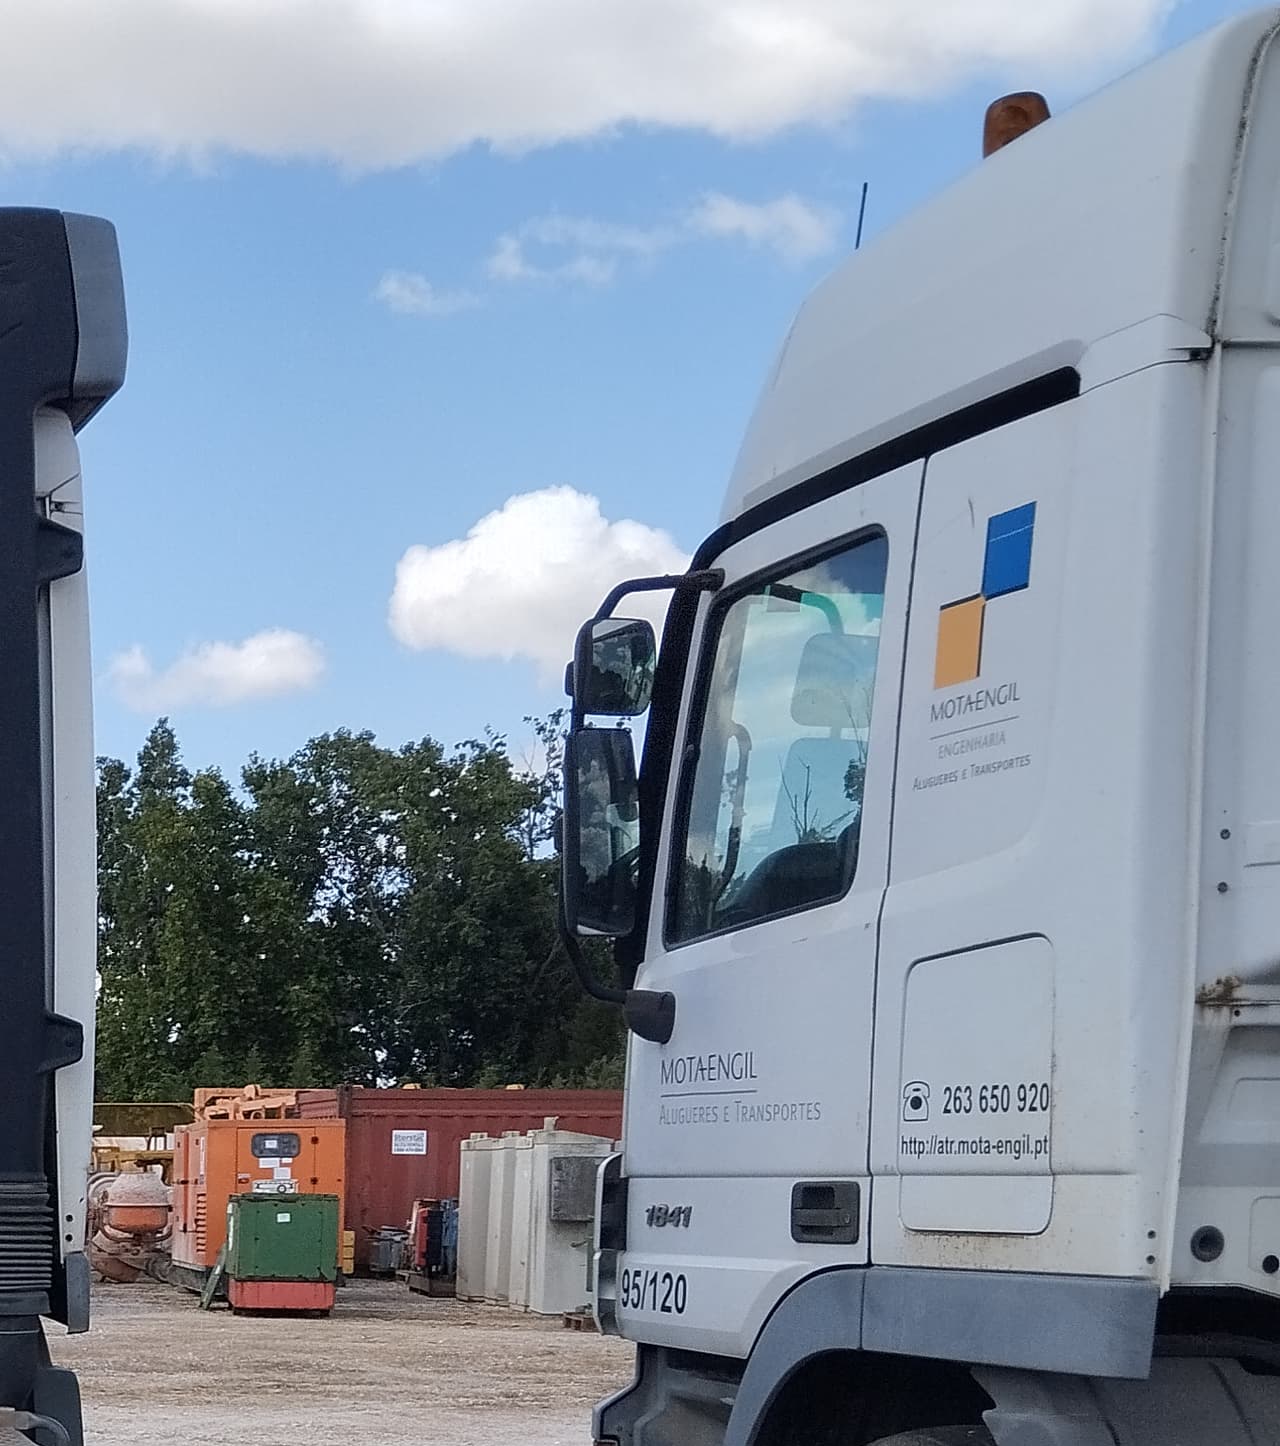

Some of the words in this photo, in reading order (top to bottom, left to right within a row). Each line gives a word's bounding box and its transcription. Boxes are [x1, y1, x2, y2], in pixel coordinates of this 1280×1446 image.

[937, 731, 1006, 760] ENGENHARIA
[970, 753, 1032, 778] TRANSPORTES
[942, 1086, 973, 1114] 263
[979, 1085, 1011, 1113] 650
[1017, 1083, 1050, 1112] 920
[659, 1103, 719, 1125] ALUGUERES
[734, 1101, 822, 1122] TRANSPORTES
[901, 1134, 1049, 1160] http://atr.mota-engil.pt
[645, 1204, 692, 1228] 1841
[621, 1268, 687, 1314] 95/120
